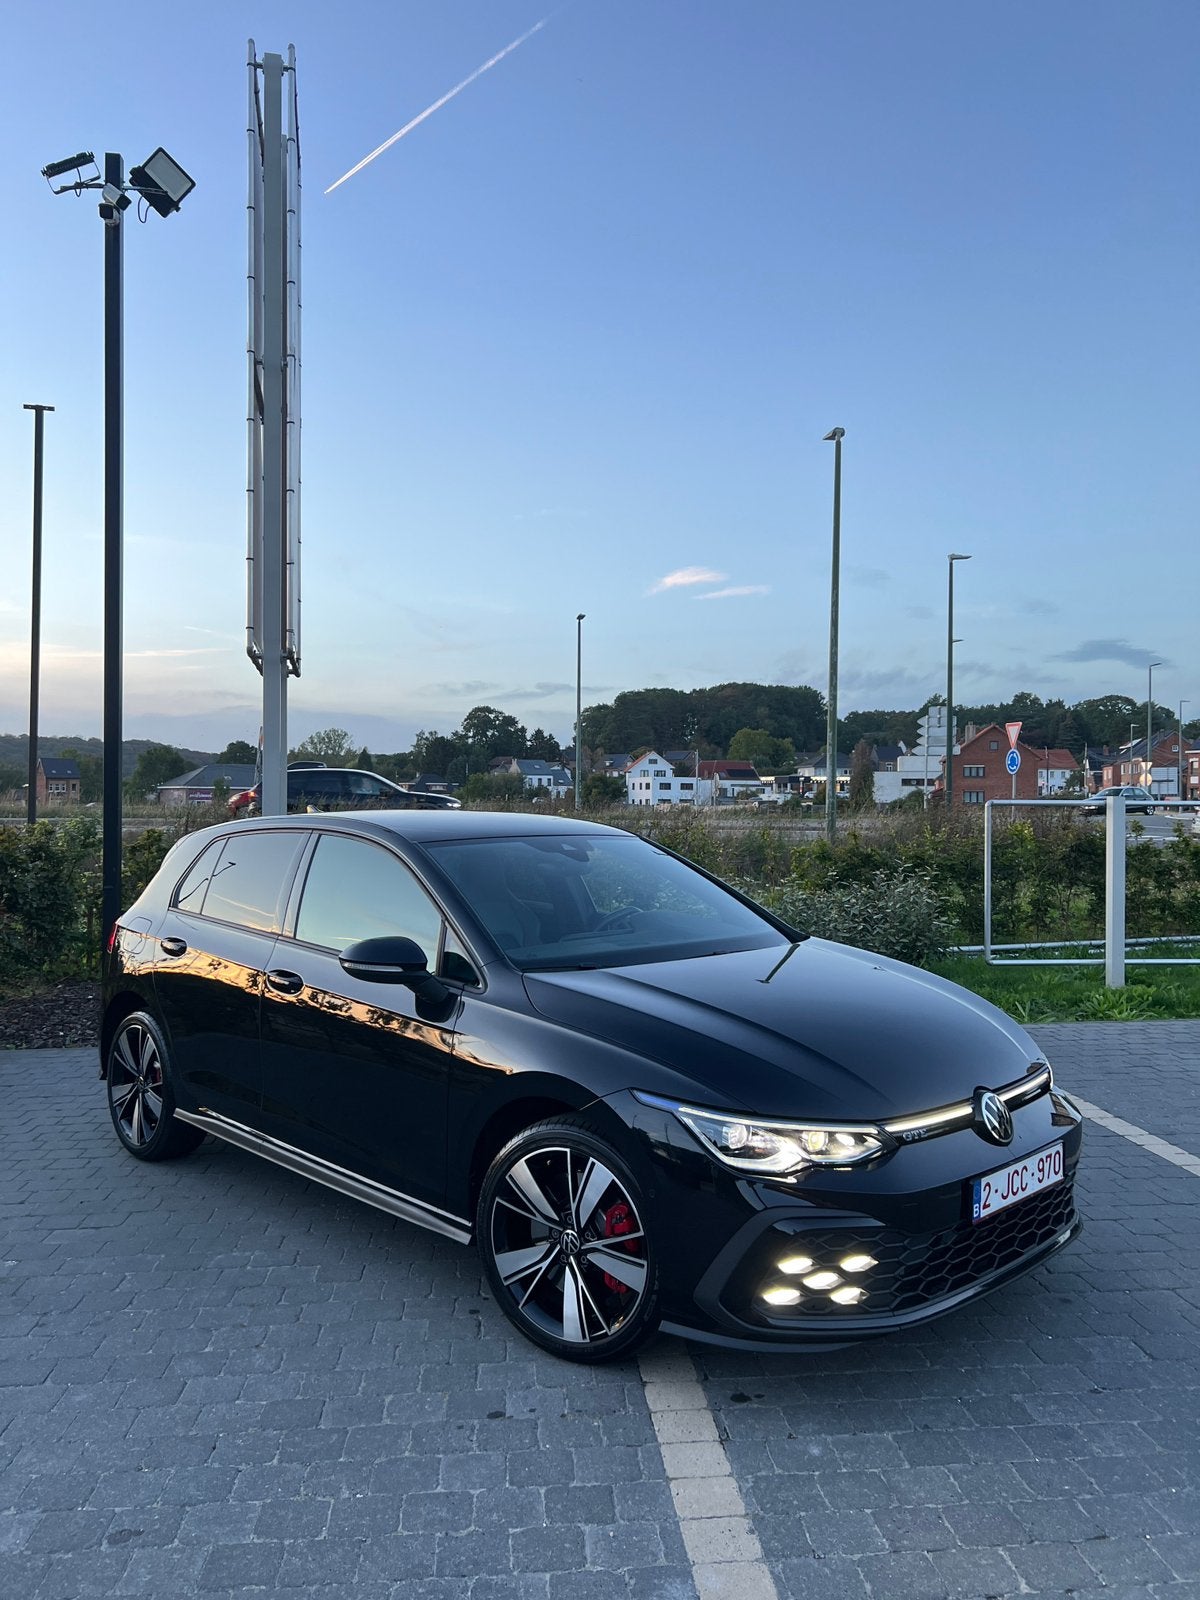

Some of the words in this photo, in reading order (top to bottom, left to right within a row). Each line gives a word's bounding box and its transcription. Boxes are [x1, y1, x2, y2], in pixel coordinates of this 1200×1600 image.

[981, 1092, 1014, 1143] VW
[903, 1128, 928, 1141] GTE
[973, 1203, 980, 1217] B
